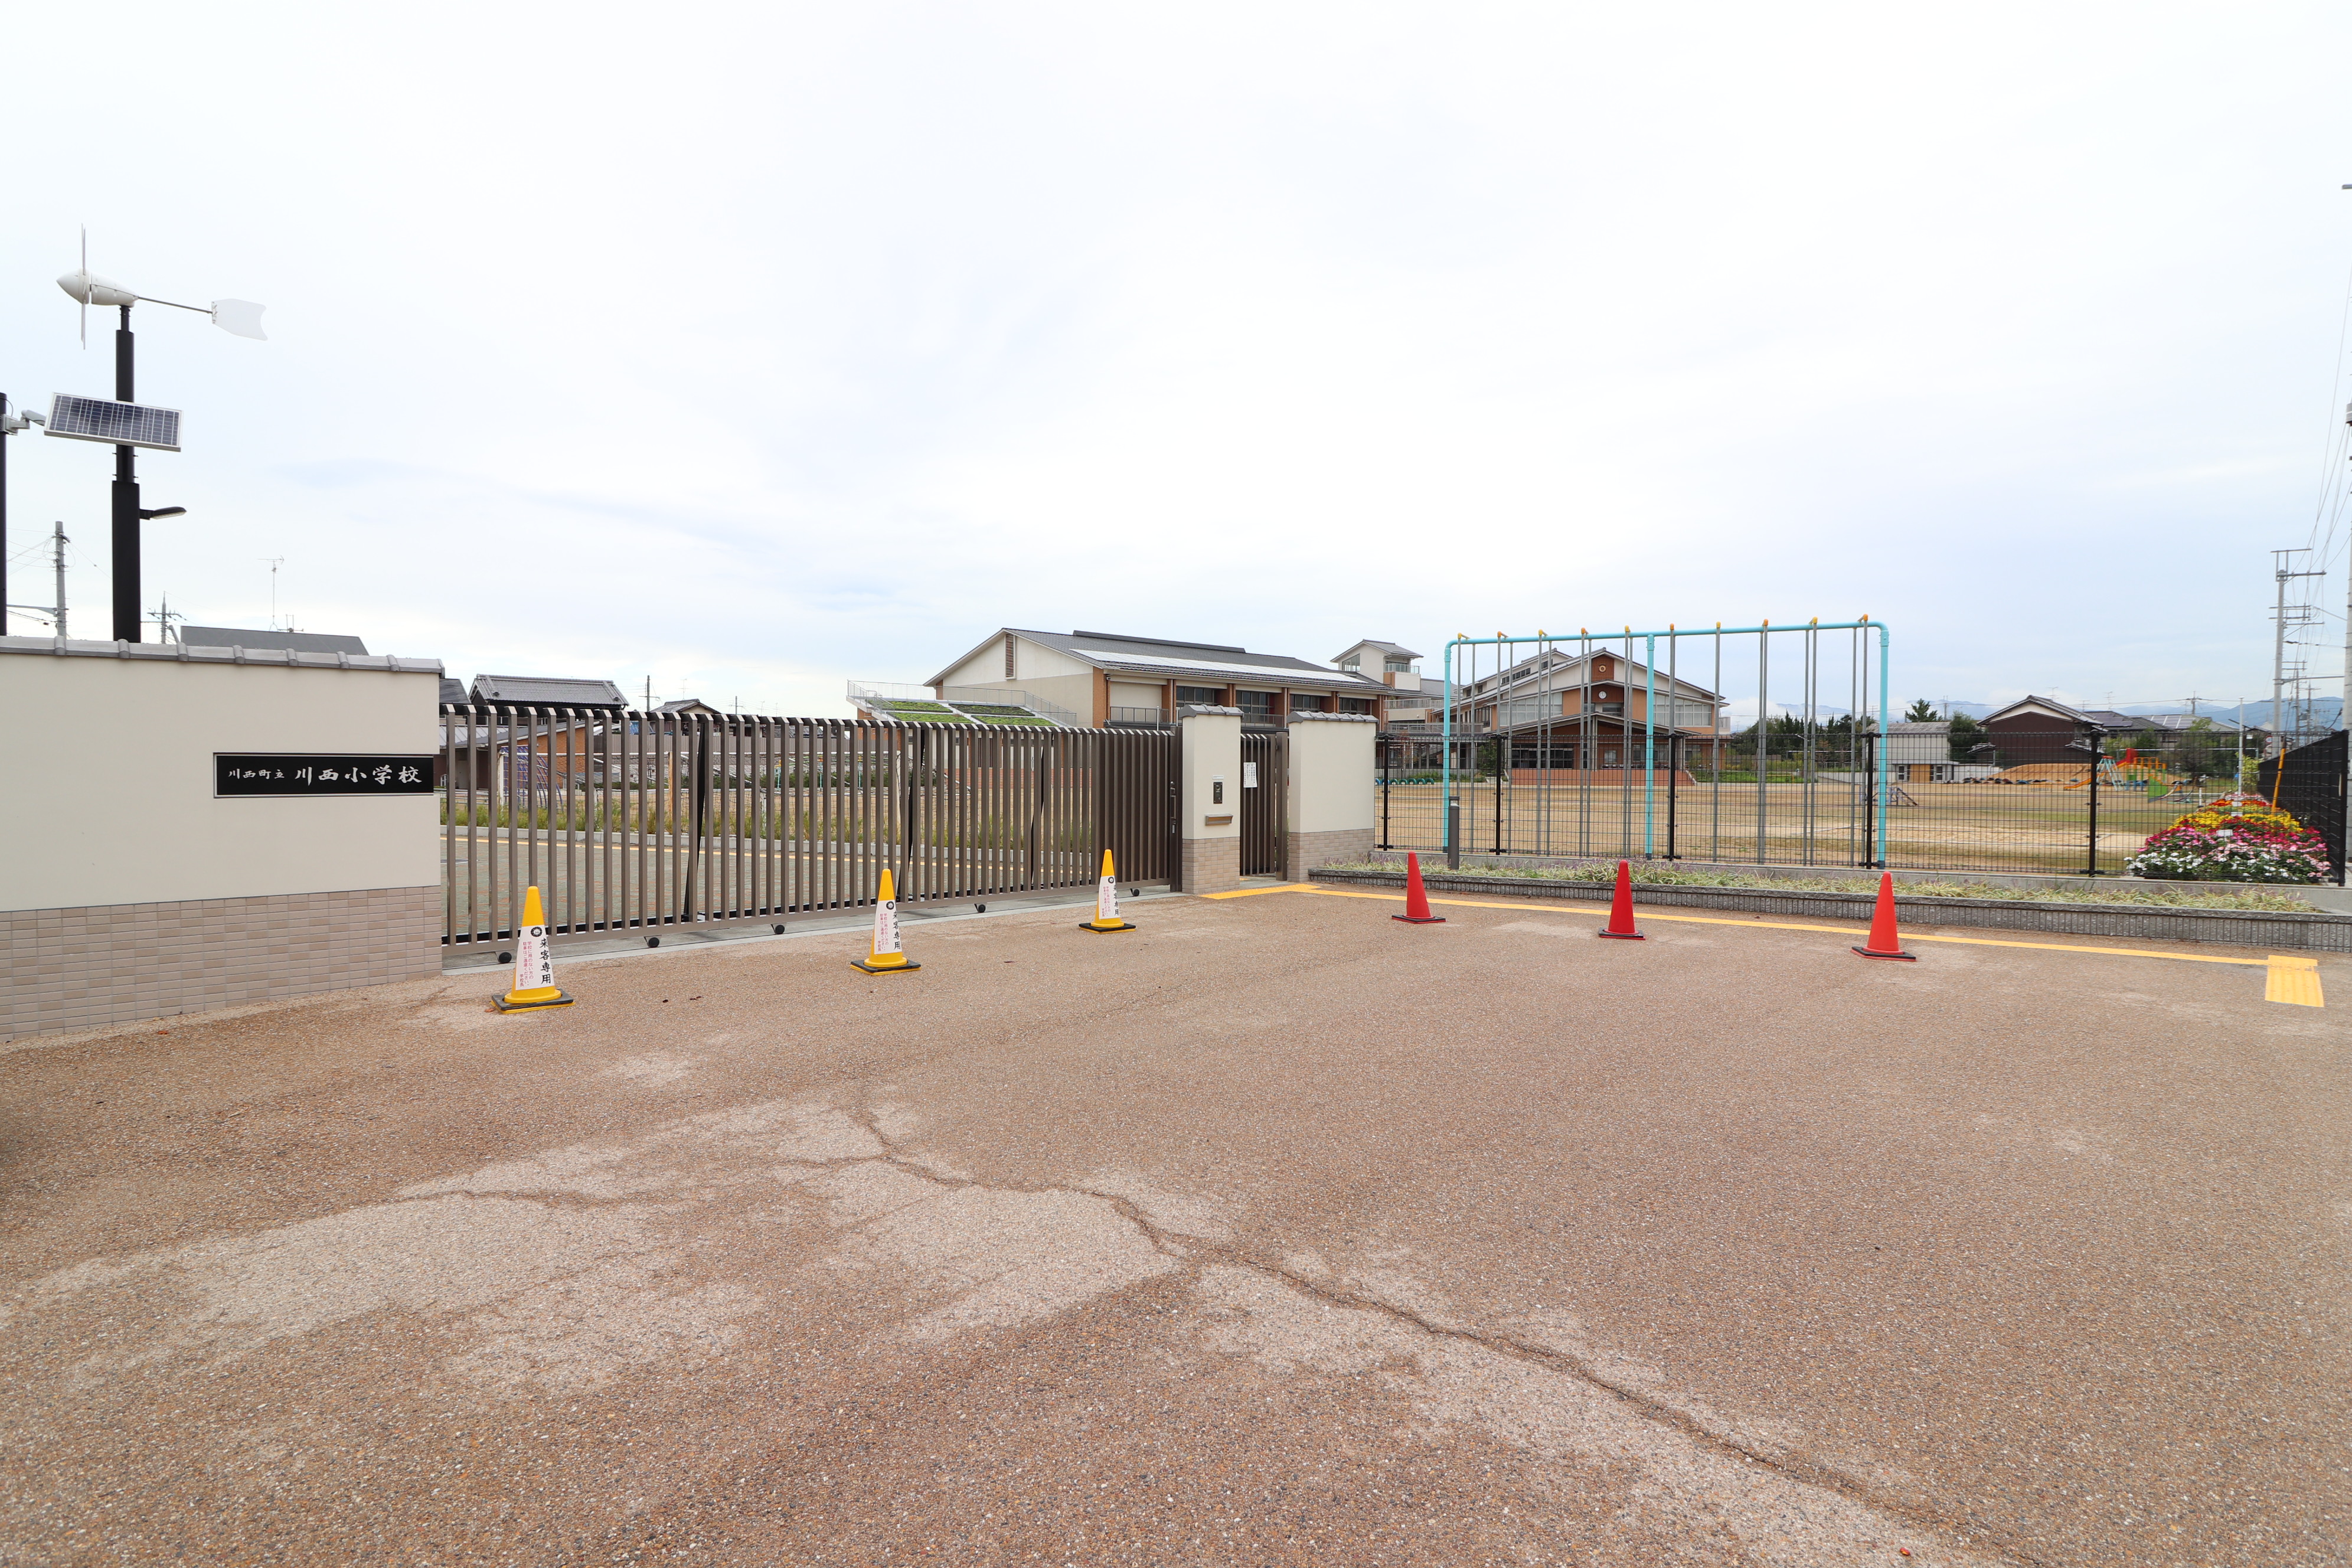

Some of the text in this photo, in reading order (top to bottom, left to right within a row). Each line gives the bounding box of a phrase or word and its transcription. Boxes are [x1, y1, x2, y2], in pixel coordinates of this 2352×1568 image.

[228, 765, 422, 786] 川西町立 川西小学校
[539, 937, 551, 984] 来客専用
